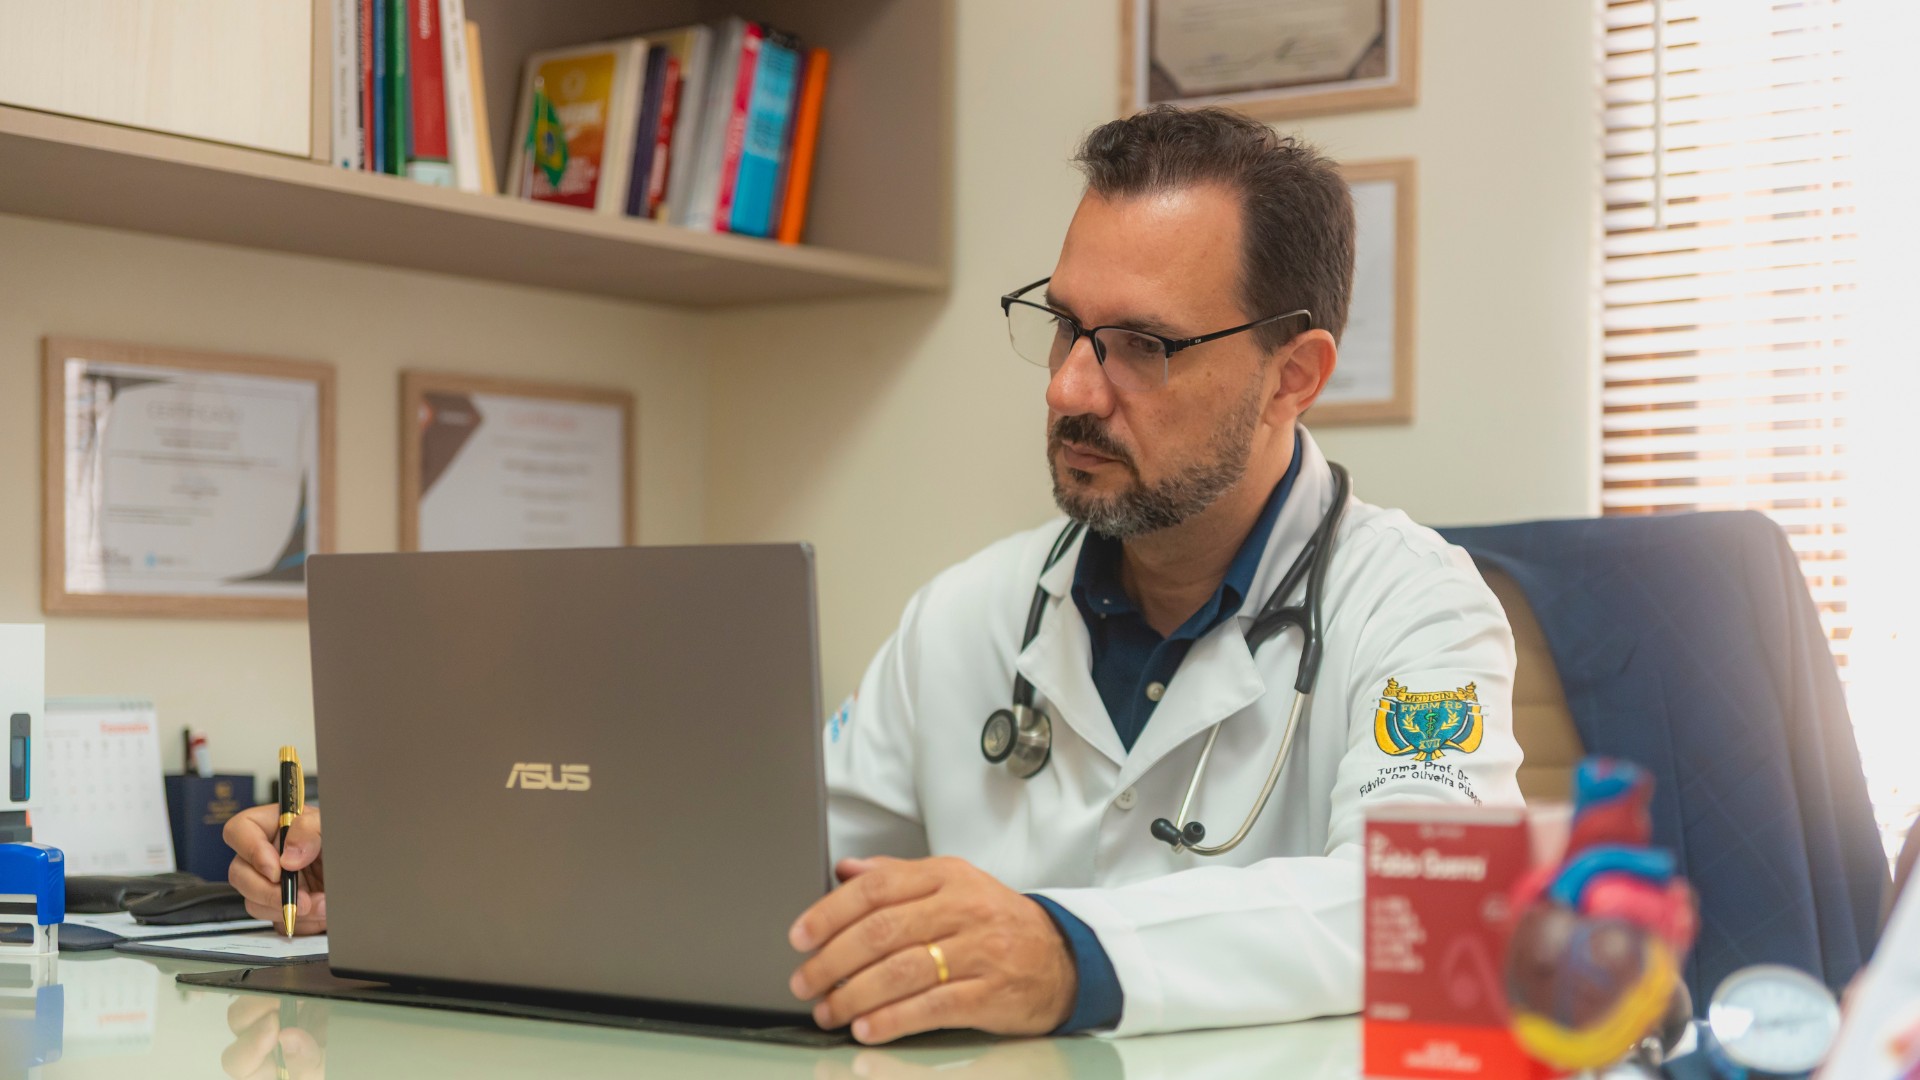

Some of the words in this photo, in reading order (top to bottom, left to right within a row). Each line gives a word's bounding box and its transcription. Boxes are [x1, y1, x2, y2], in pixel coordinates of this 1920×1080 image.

[1404, 692, 1461, 703] MEDICINA
[505, 763, 591, 791] ASUS
[1359, 776, 1386, 797] Flávio
[1411, 771, 1454, 787] Oliveira
[1378, 764, 1417, 775] Turma
[1424, 761, 1453, 776] Prof.
[1457, 769, 1471, 786] Dr.
